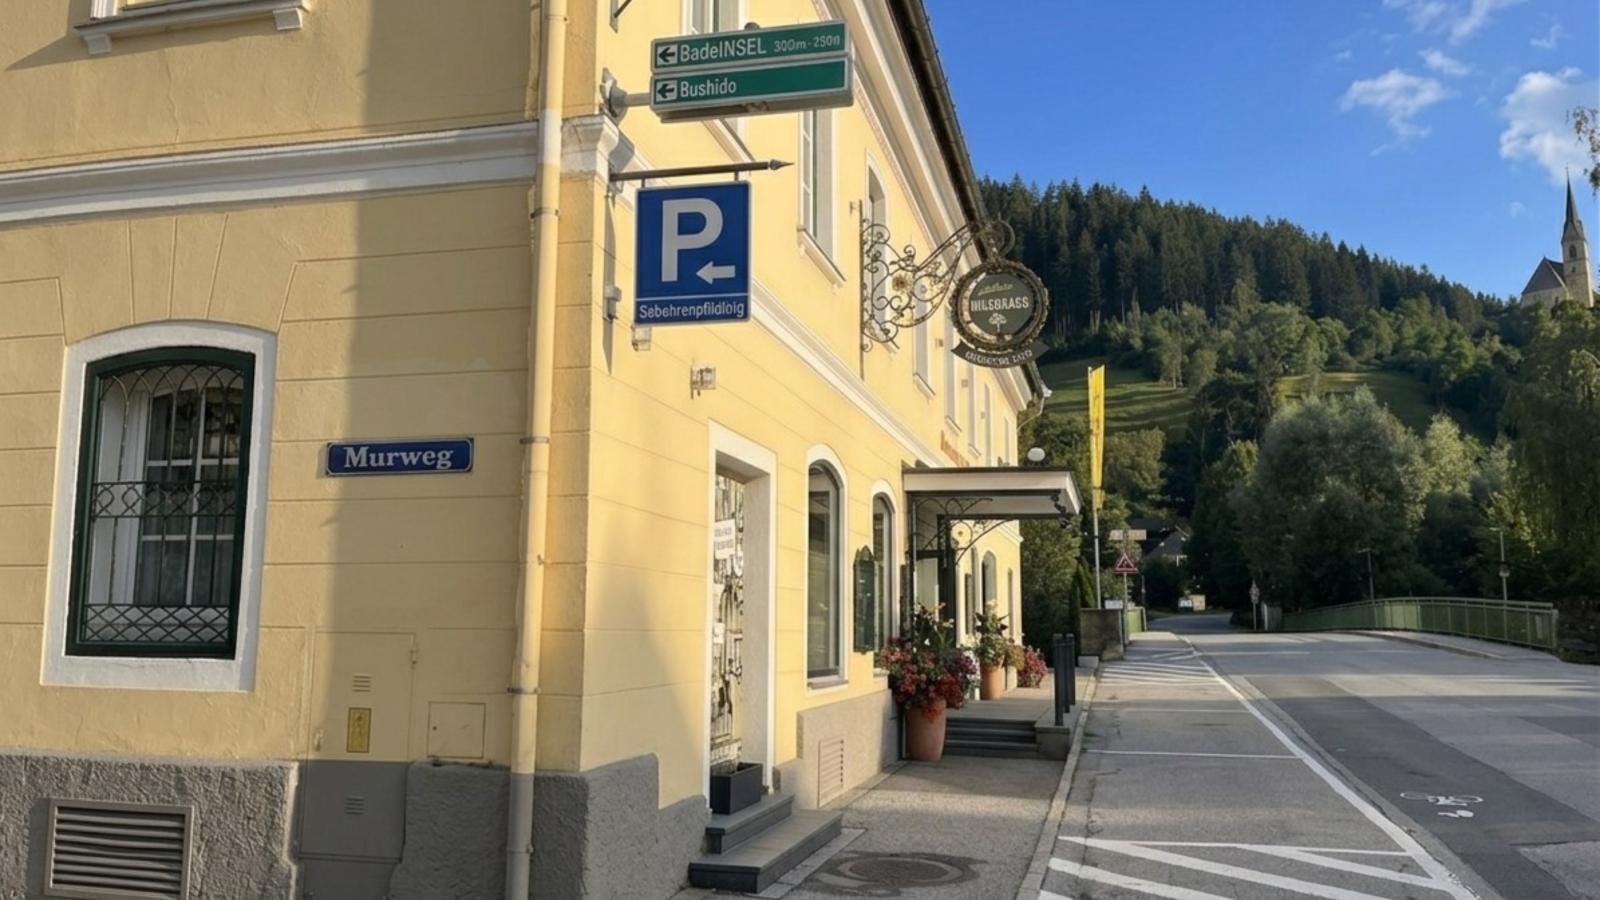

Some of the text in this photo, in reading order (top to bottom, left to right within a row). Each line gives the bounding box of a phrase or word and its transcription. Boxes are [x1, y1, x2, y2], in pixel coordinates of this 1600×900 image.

[680, 38, 767, 62] BadeINSEL
[680, 78, 737, 98] Bushido
[661, 197, 723, 282] P
[343, 446, 454, 470] Murweg
